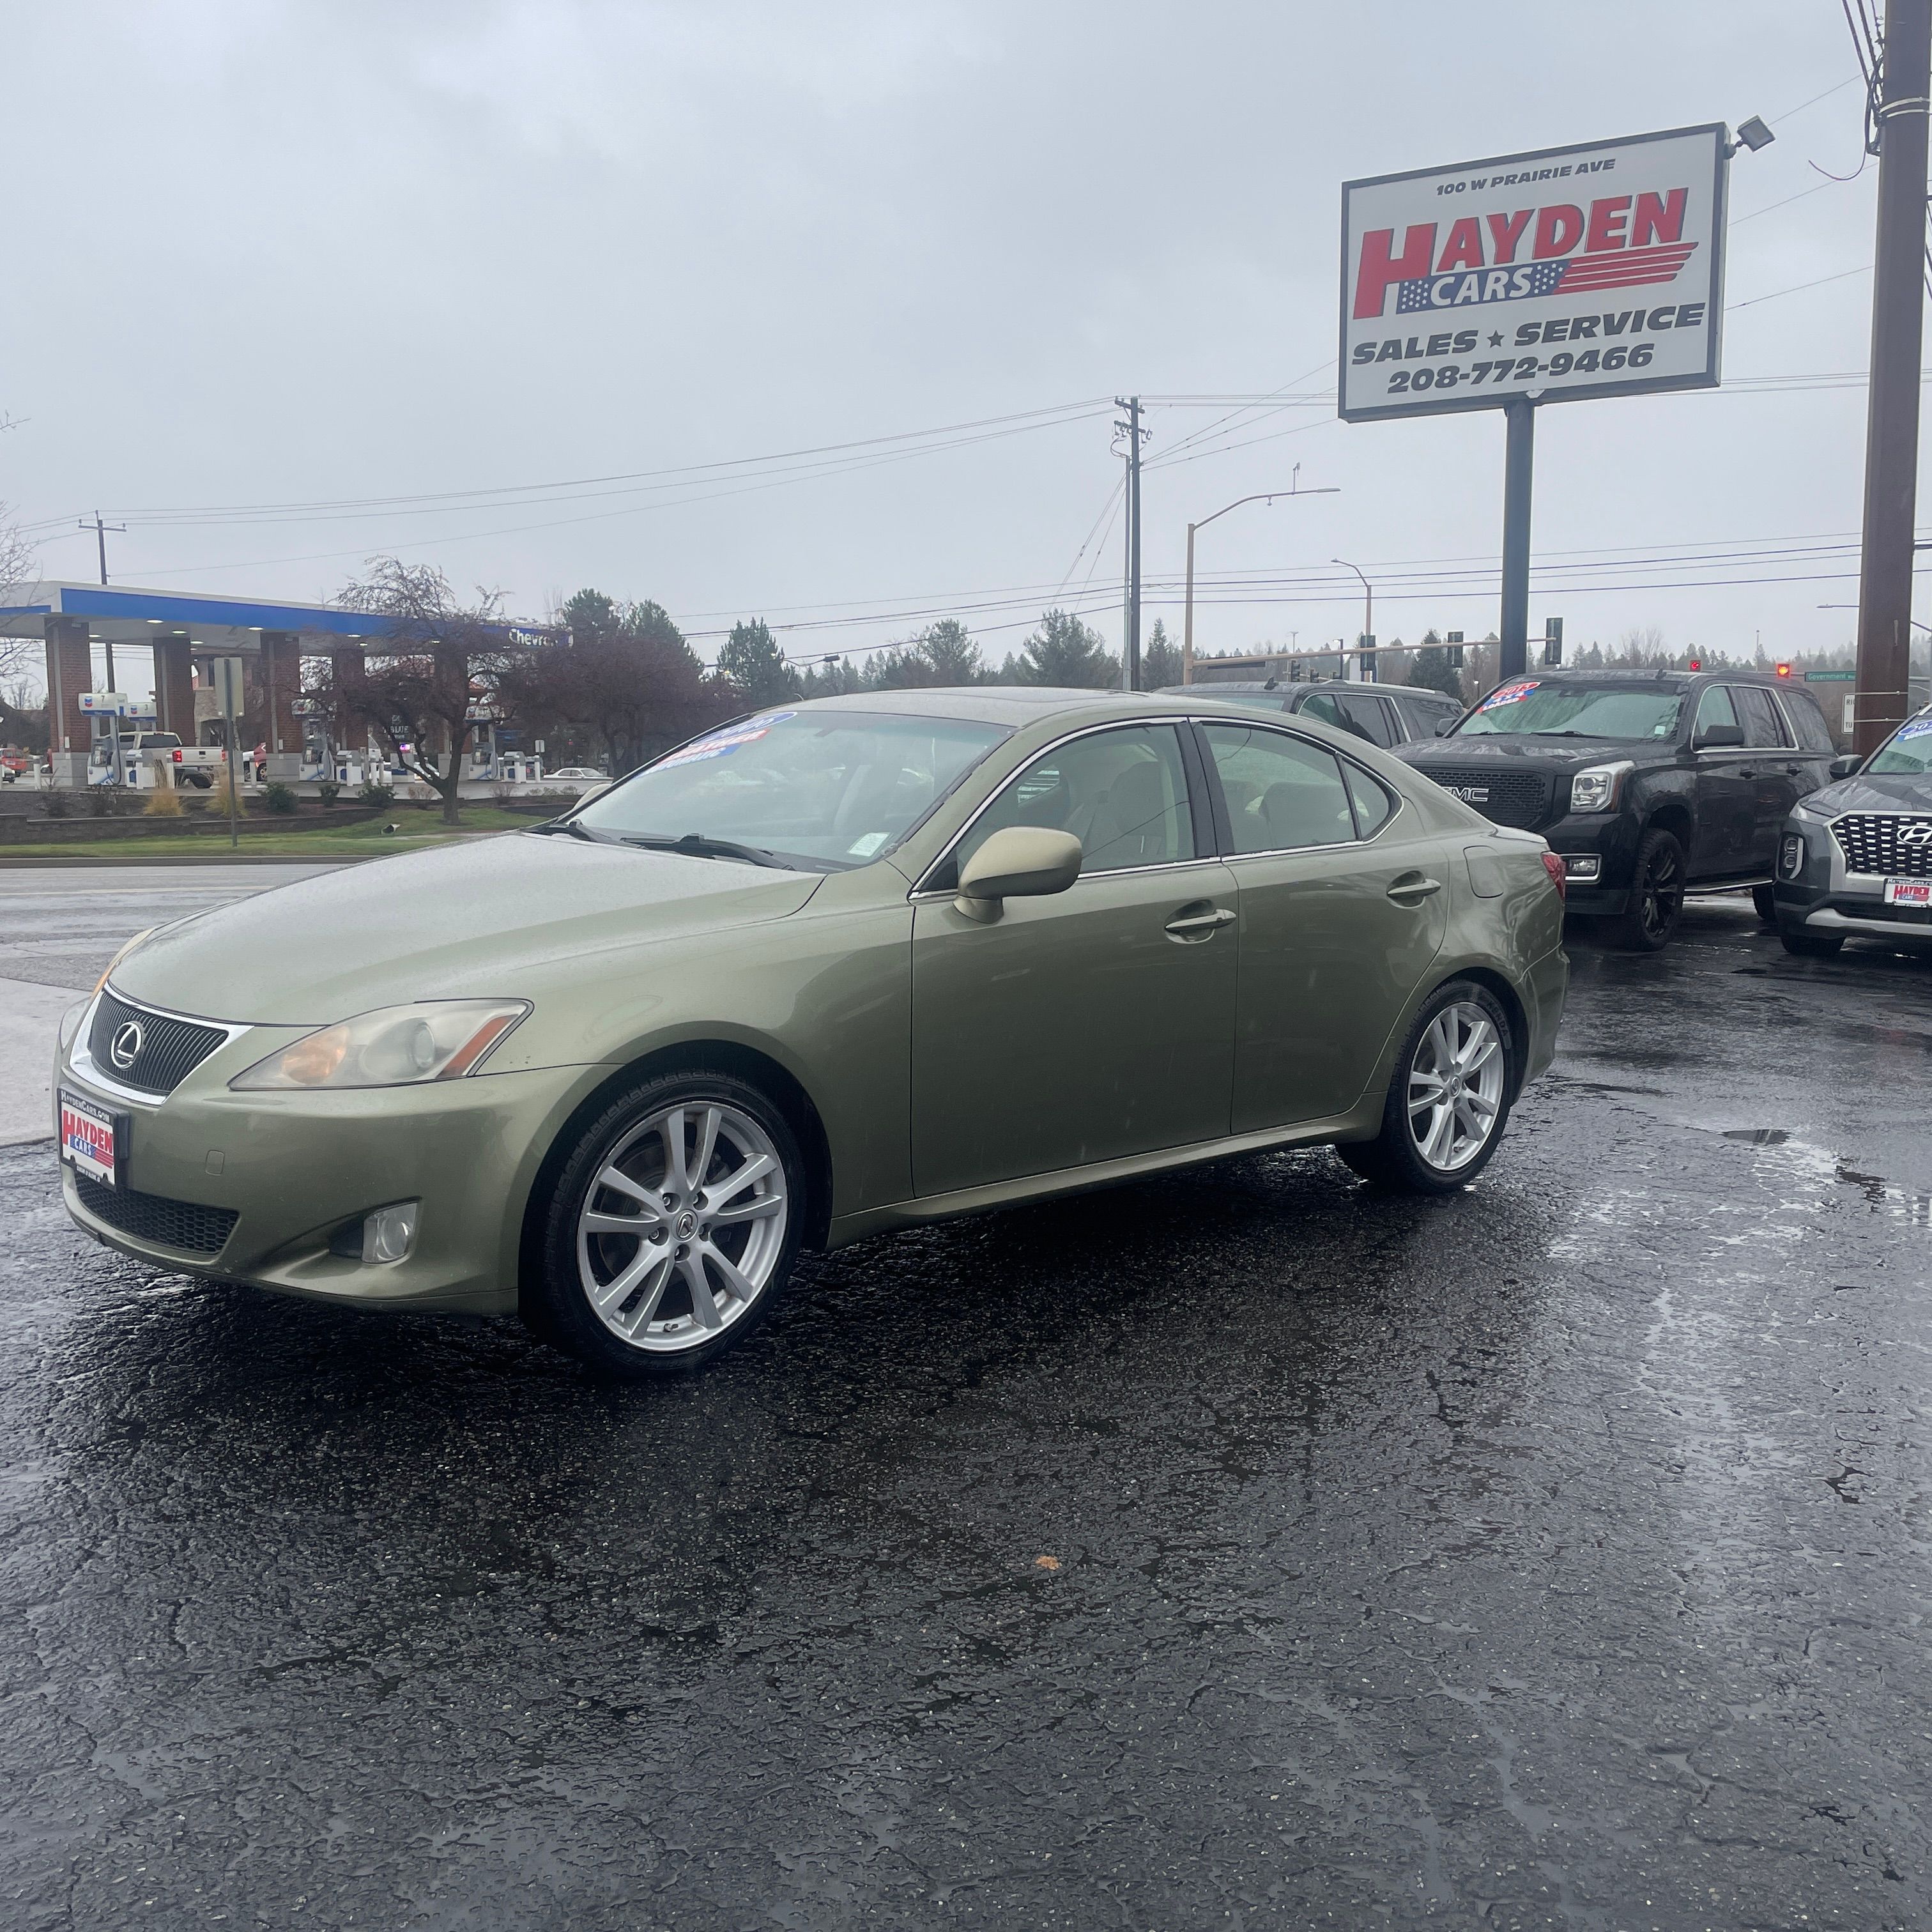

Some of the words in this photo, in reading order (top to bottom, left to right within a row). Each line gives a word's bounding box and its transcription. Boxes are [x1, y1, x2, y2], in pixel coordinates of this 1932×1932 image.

[1437, 182, 1466, 195] 100
[1471, 178, 1487, 191] W
[1491, 165, 1572, 188] PRAIRIE
[1575, 158, 1616, 176] AVE
[1353, 187, 1689, 319] HAYDEN
[1430, 266, 1533, 307] CARS
[1352, 330, 1478, 365] SALES
[1514, 302, 1705, 346] SERVICE
[1388, 343, 1655, 394] 208-772-9466
[509, 628, 558, 647] Chevro
[1441, 786, 1489, 802] MC
[63, 1109, 113, 1154] HAYDEN
[74, 1137, 91, 1156] CARS
